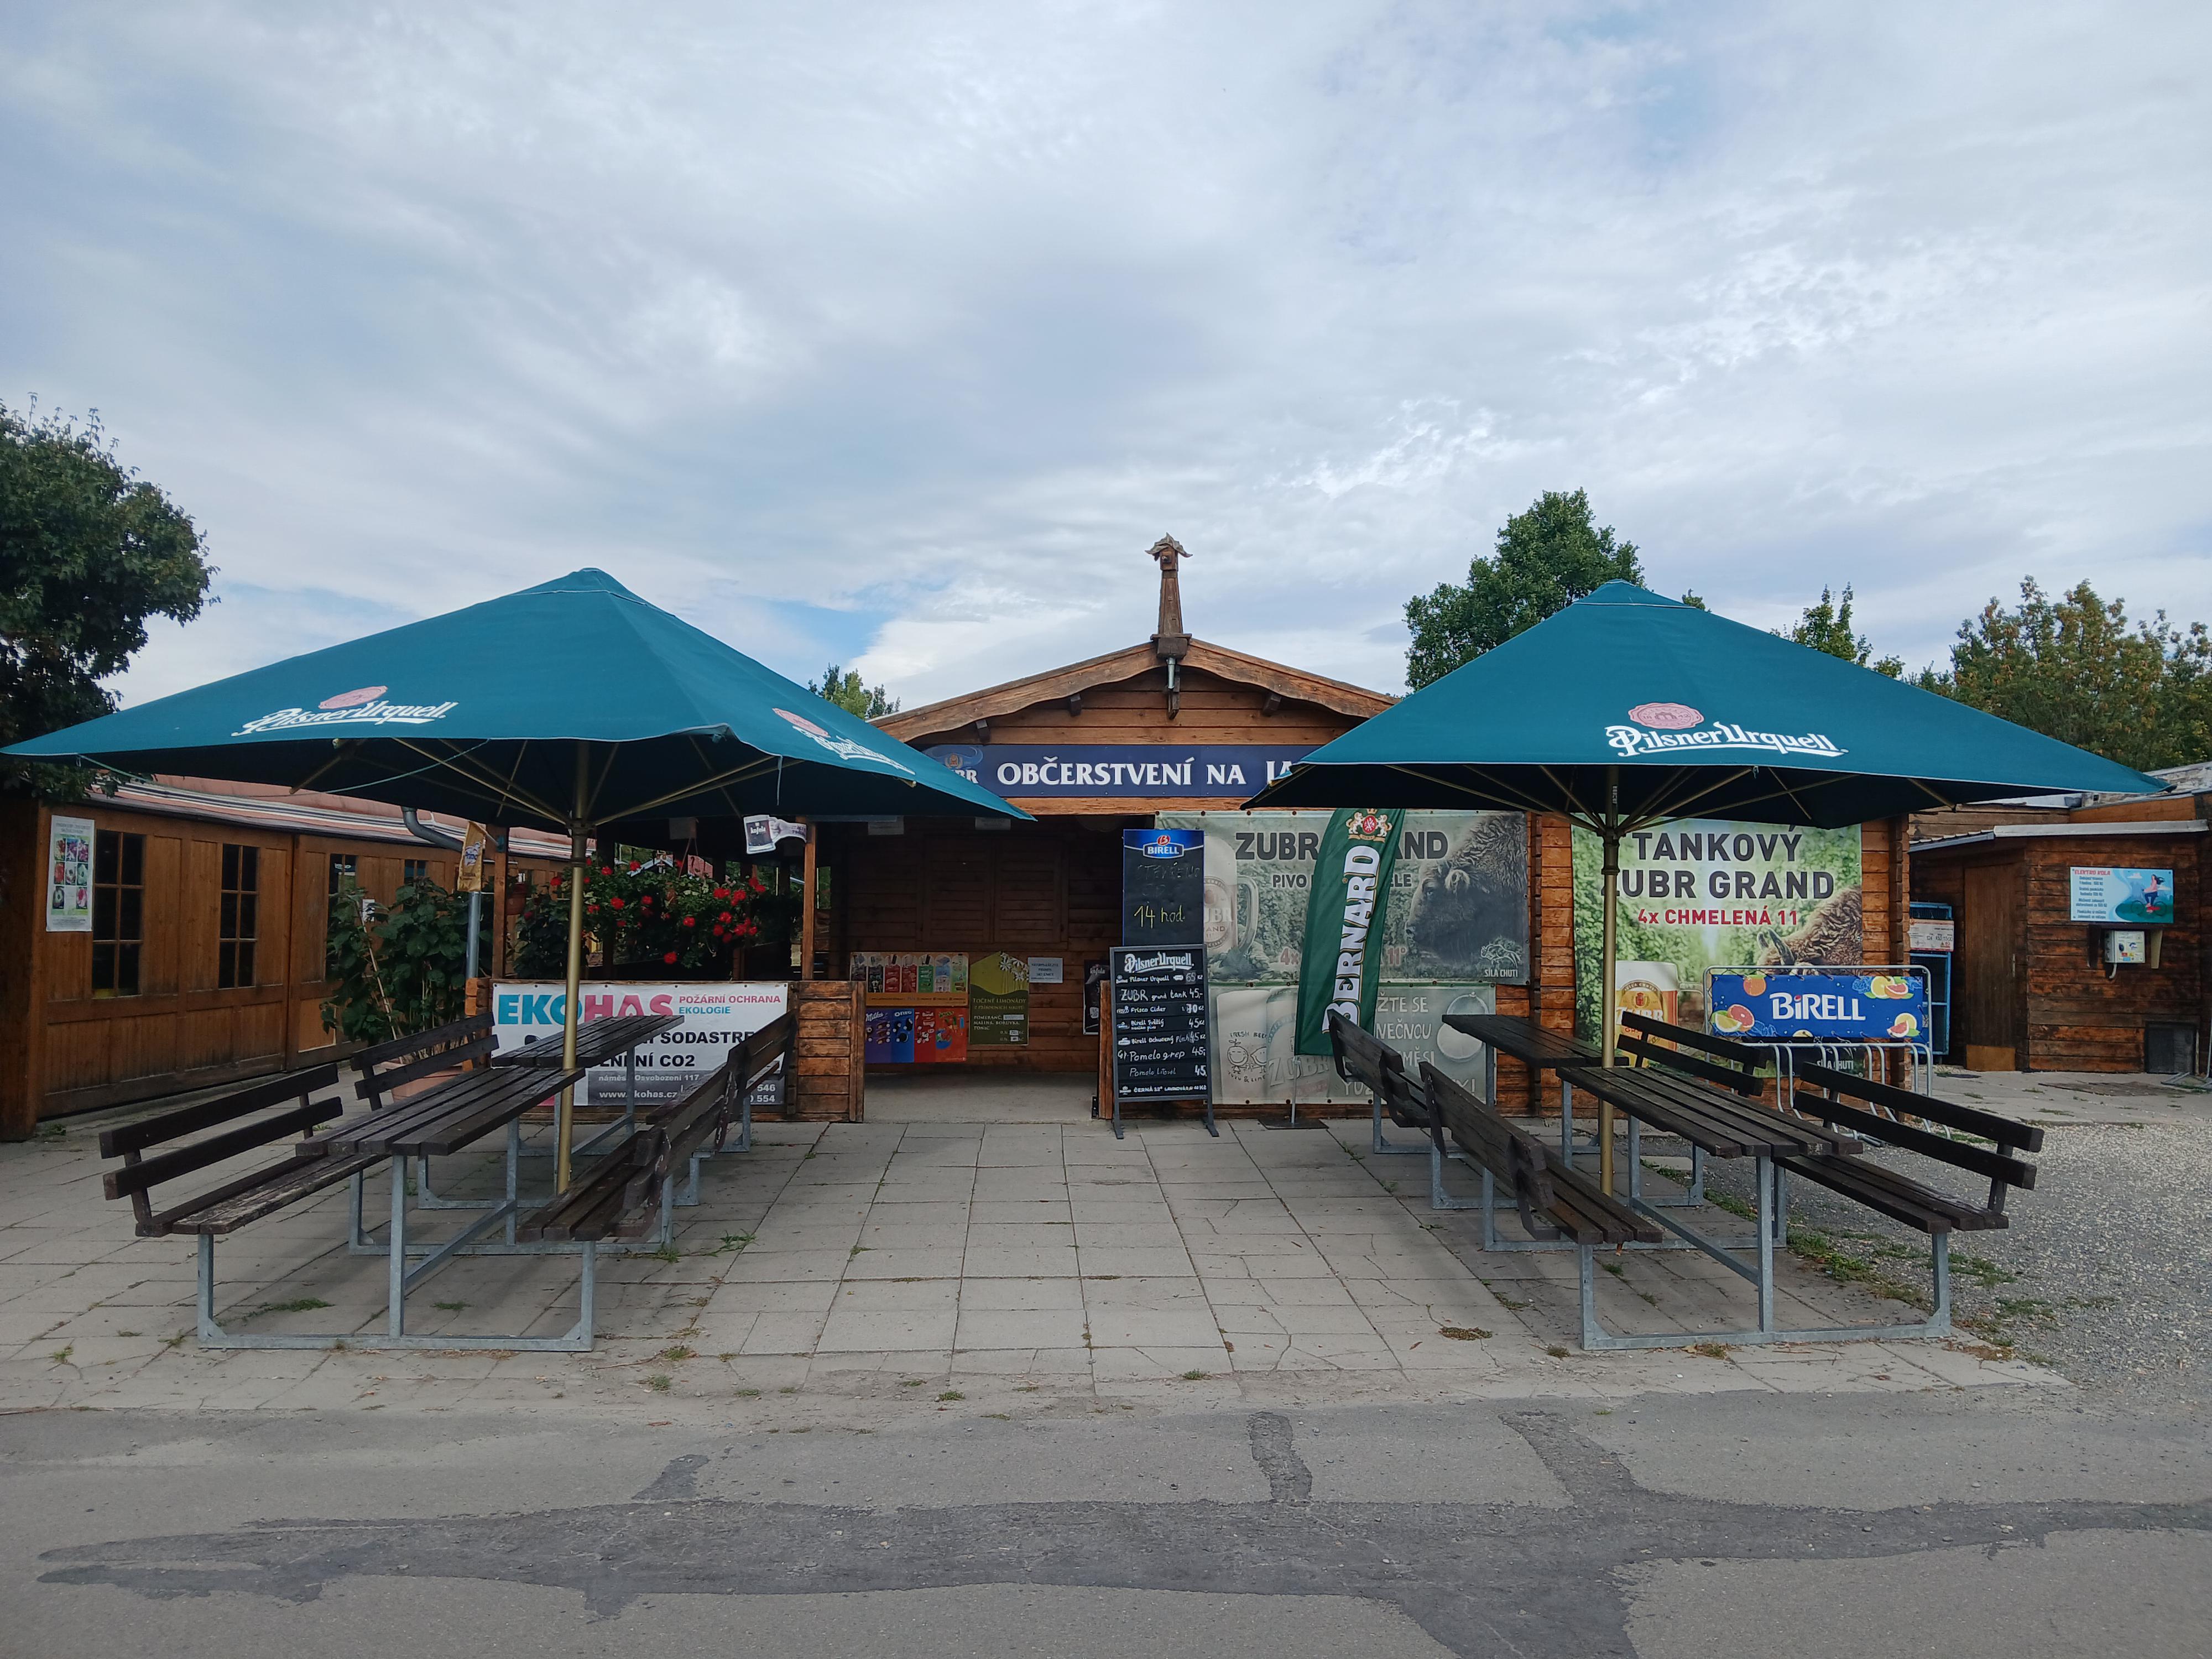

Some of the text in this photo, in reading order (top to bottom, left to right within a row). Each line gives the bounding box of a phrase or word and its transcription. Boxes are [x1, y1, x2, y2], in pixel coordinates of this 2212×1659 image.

[1605, 724, 1722, 757] Pilsner
[997, 756, 1195, 785] OBČERSTVENÍ
[1206, 765, 1246, 784] NA
[1235, 832, 1319, 860] ZUBR
[1632, 824, 1803, 862] TANKOVÝ
[1272, 874, 1307, 888] PIVO
[1601, 870, 1835, 900] UBR GRAND
[1134, 905, 1156, 929] 14
[1639, 905, 1798, 925] 4x CHMELENÁ 11
[1124, 953, 1160, 973] Pilsner
[1186, 972, 1196, 982] 65
[679, 995, 781, 1004] POŽÁRNÍ OCHRANA
[1120, 989, 1149, 1001] ZUBR
[1170, 989, 1187, 999] tank
[679, 1006, 731, 1014] EKOLOGIE
[1412, 997, 1428, 1013] SE
[865, 1011, 884, 1022] Milka
[1189, 1018, 1199, 1028] 45
[660, 1055, 695, 1067] CO2
[1130, 1049, 1161, 1062] Pomelo
[1163, 1051, 1185, 1060] grep
